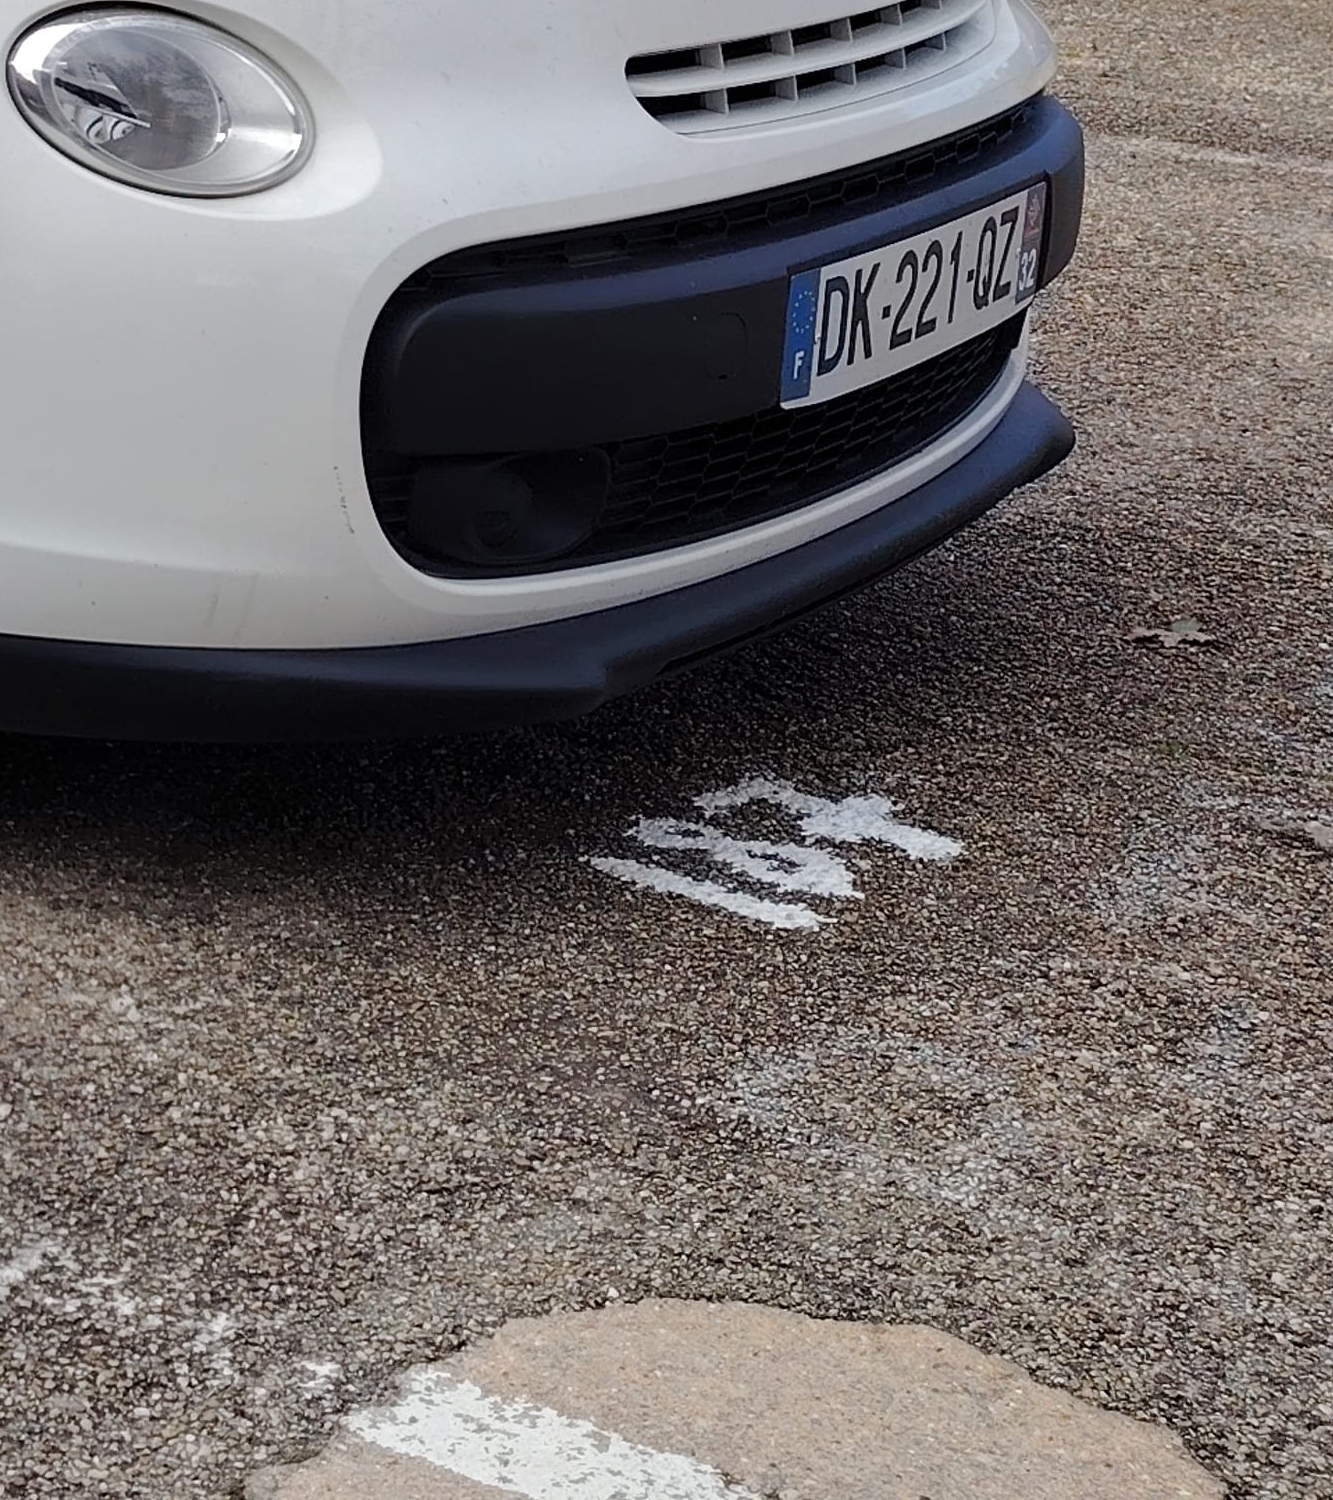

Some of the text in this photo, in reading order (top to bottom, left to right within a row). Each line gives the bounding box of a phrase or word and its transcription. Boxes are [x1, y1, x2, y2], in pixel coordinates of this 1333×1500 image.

[792, 204, 1037, 381] F DK-221-QZ 32
